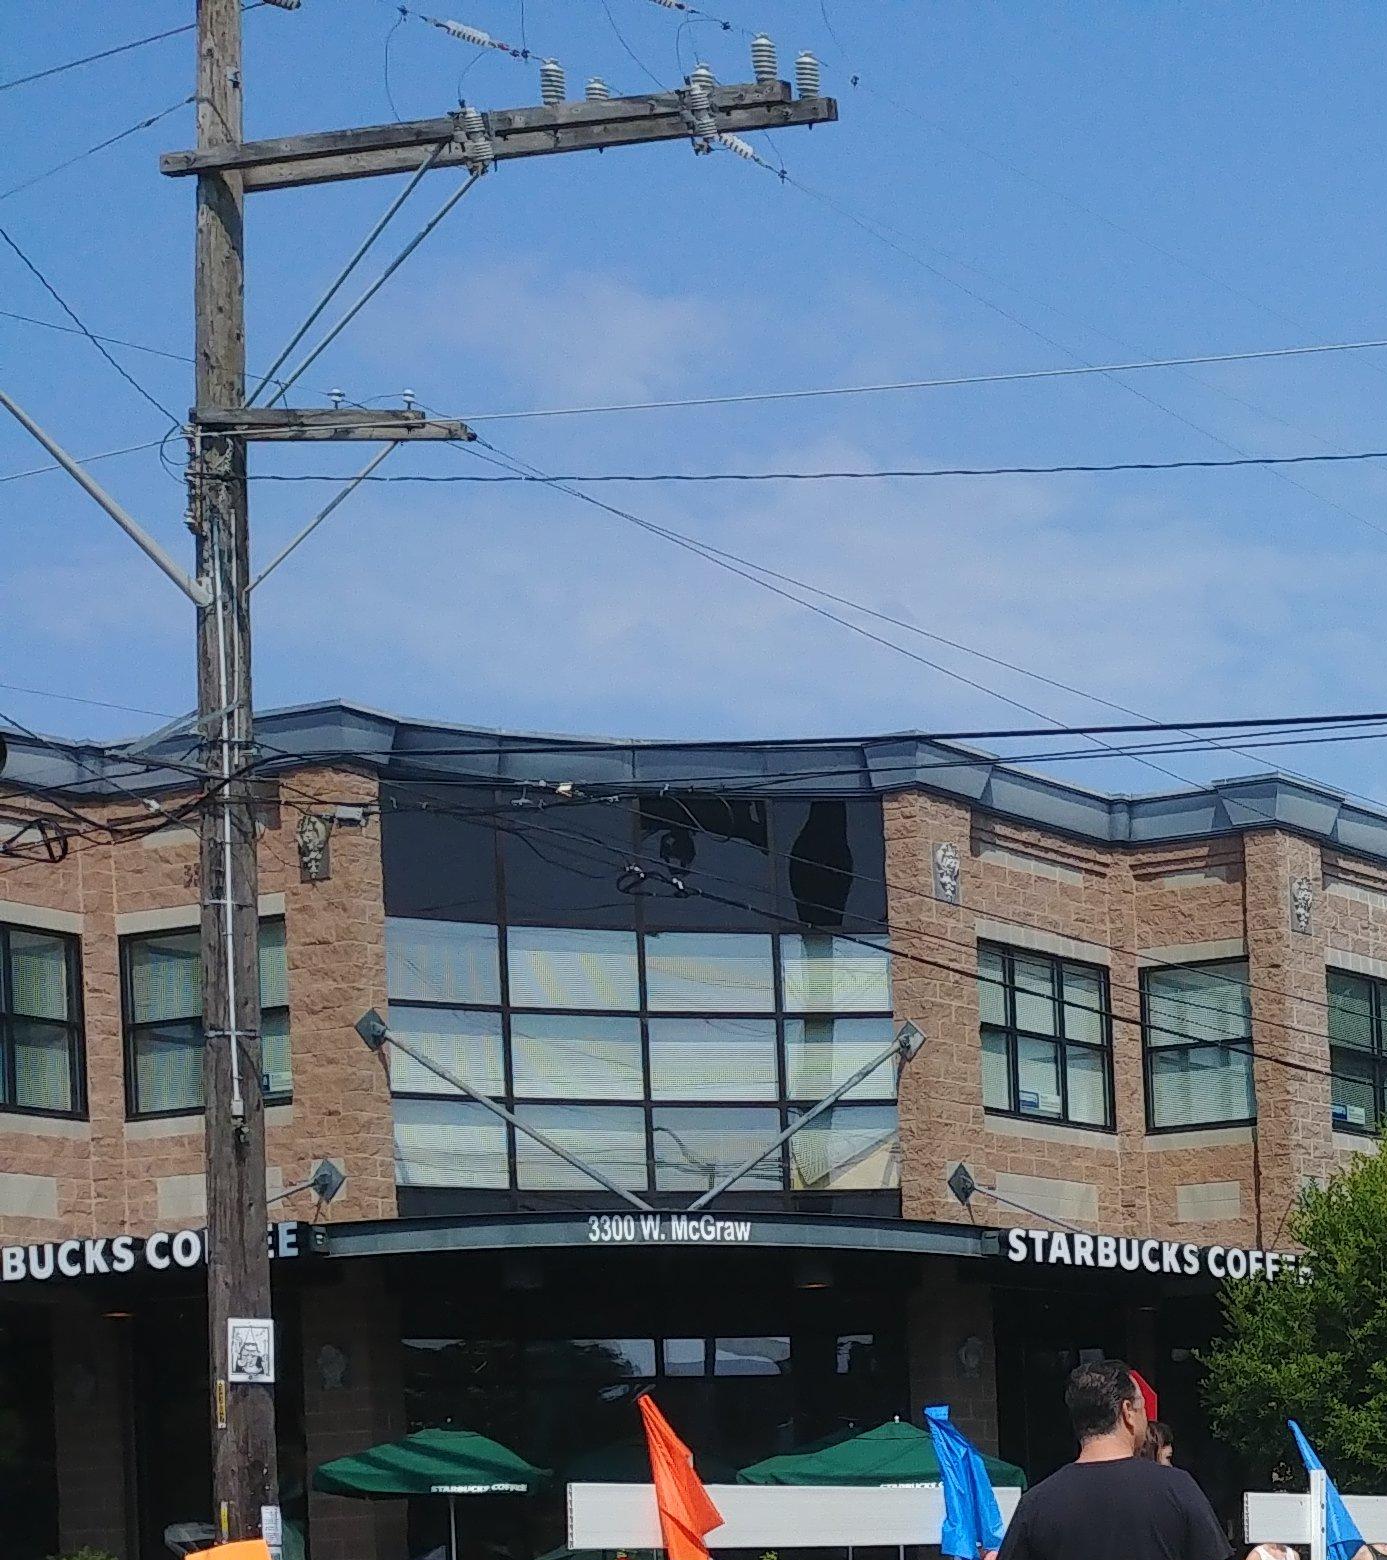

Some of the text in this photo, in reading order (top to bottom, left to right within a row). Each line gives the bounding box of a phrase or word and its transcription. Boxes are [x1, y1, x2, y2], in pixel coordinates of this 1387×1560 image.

[588, 1214, 752, 1242] 3300 W. McGraw
[1007, 1227, 1201, 1276] STARBUCKS
